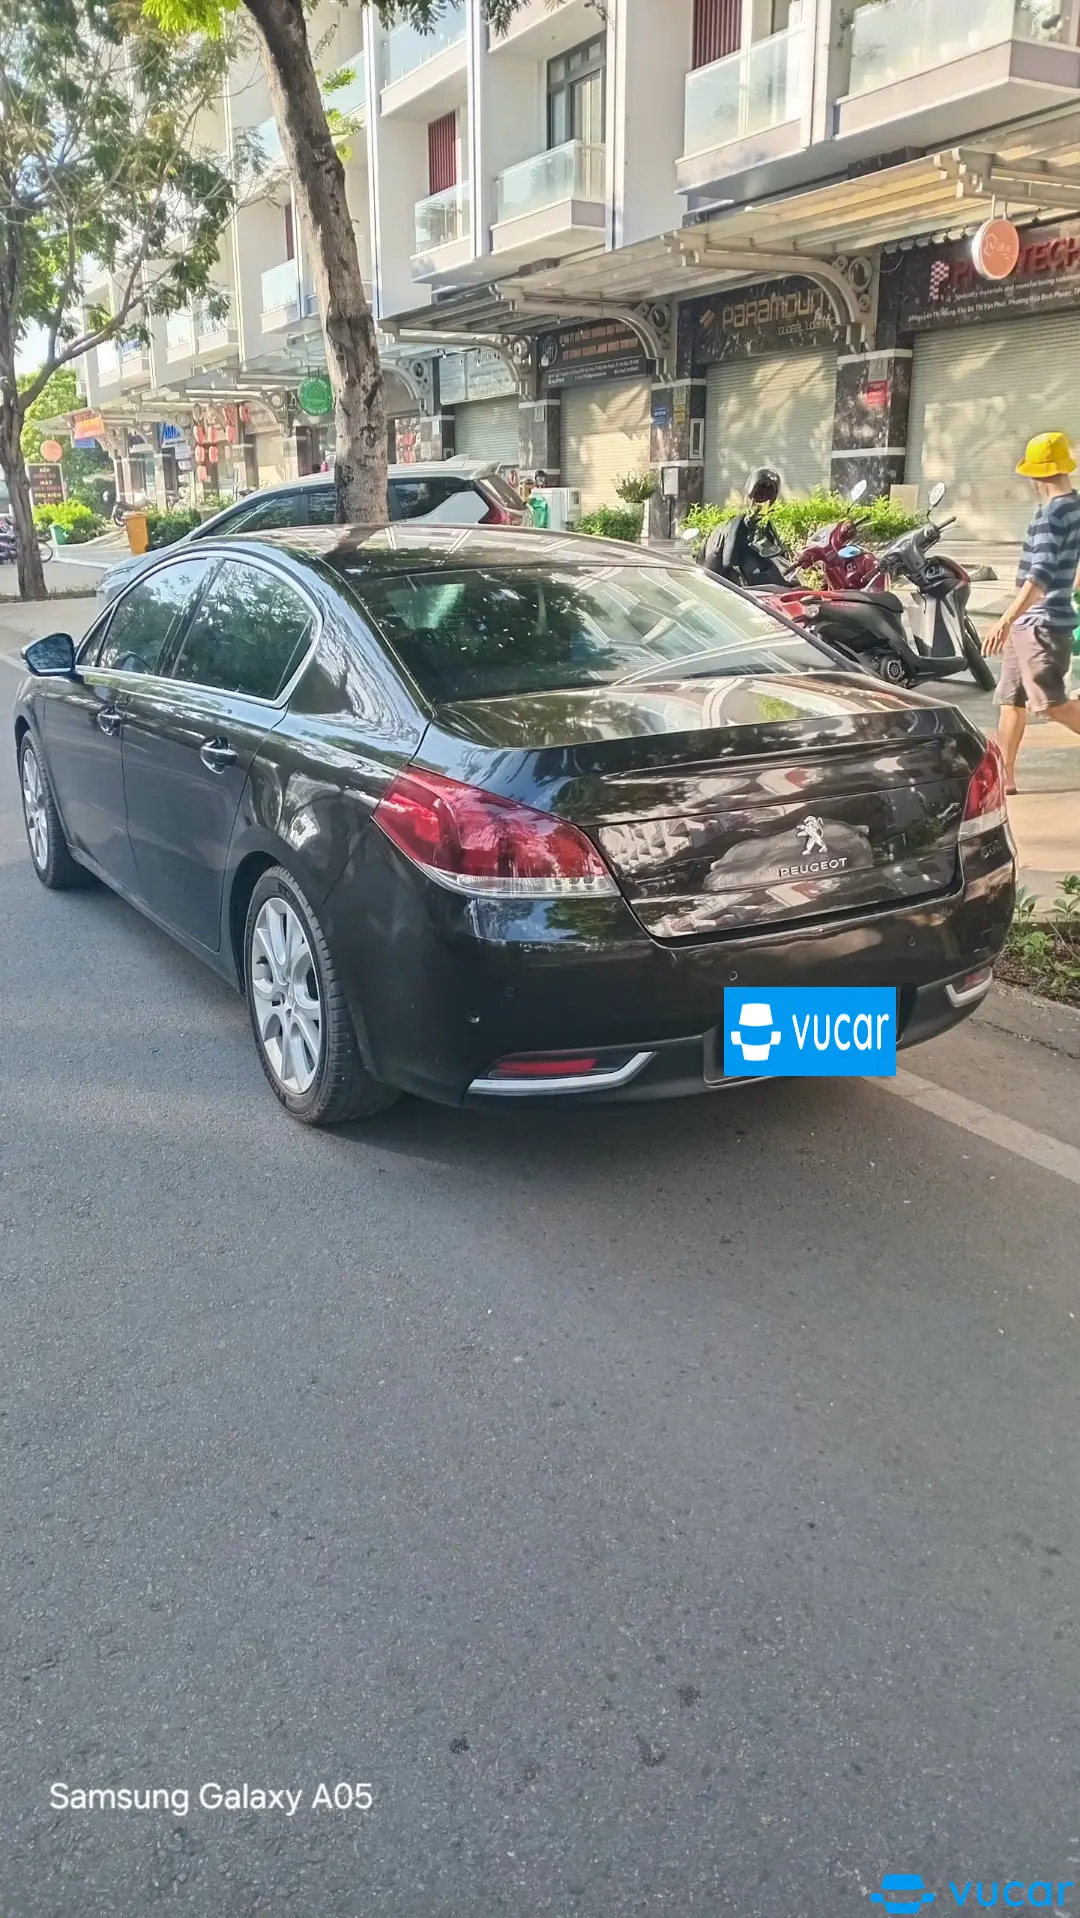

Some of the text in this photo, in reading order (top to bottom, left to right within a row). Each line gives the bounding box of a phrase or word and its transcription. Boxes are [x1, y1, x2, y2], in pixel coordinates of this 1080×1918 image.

[979, 285, 1003, 296] materials
[1004, 284, 1015, 293] and
[1015, 279, 1055, 290] manufacturing
[779, 857, 848, 877] PEUGEOT
